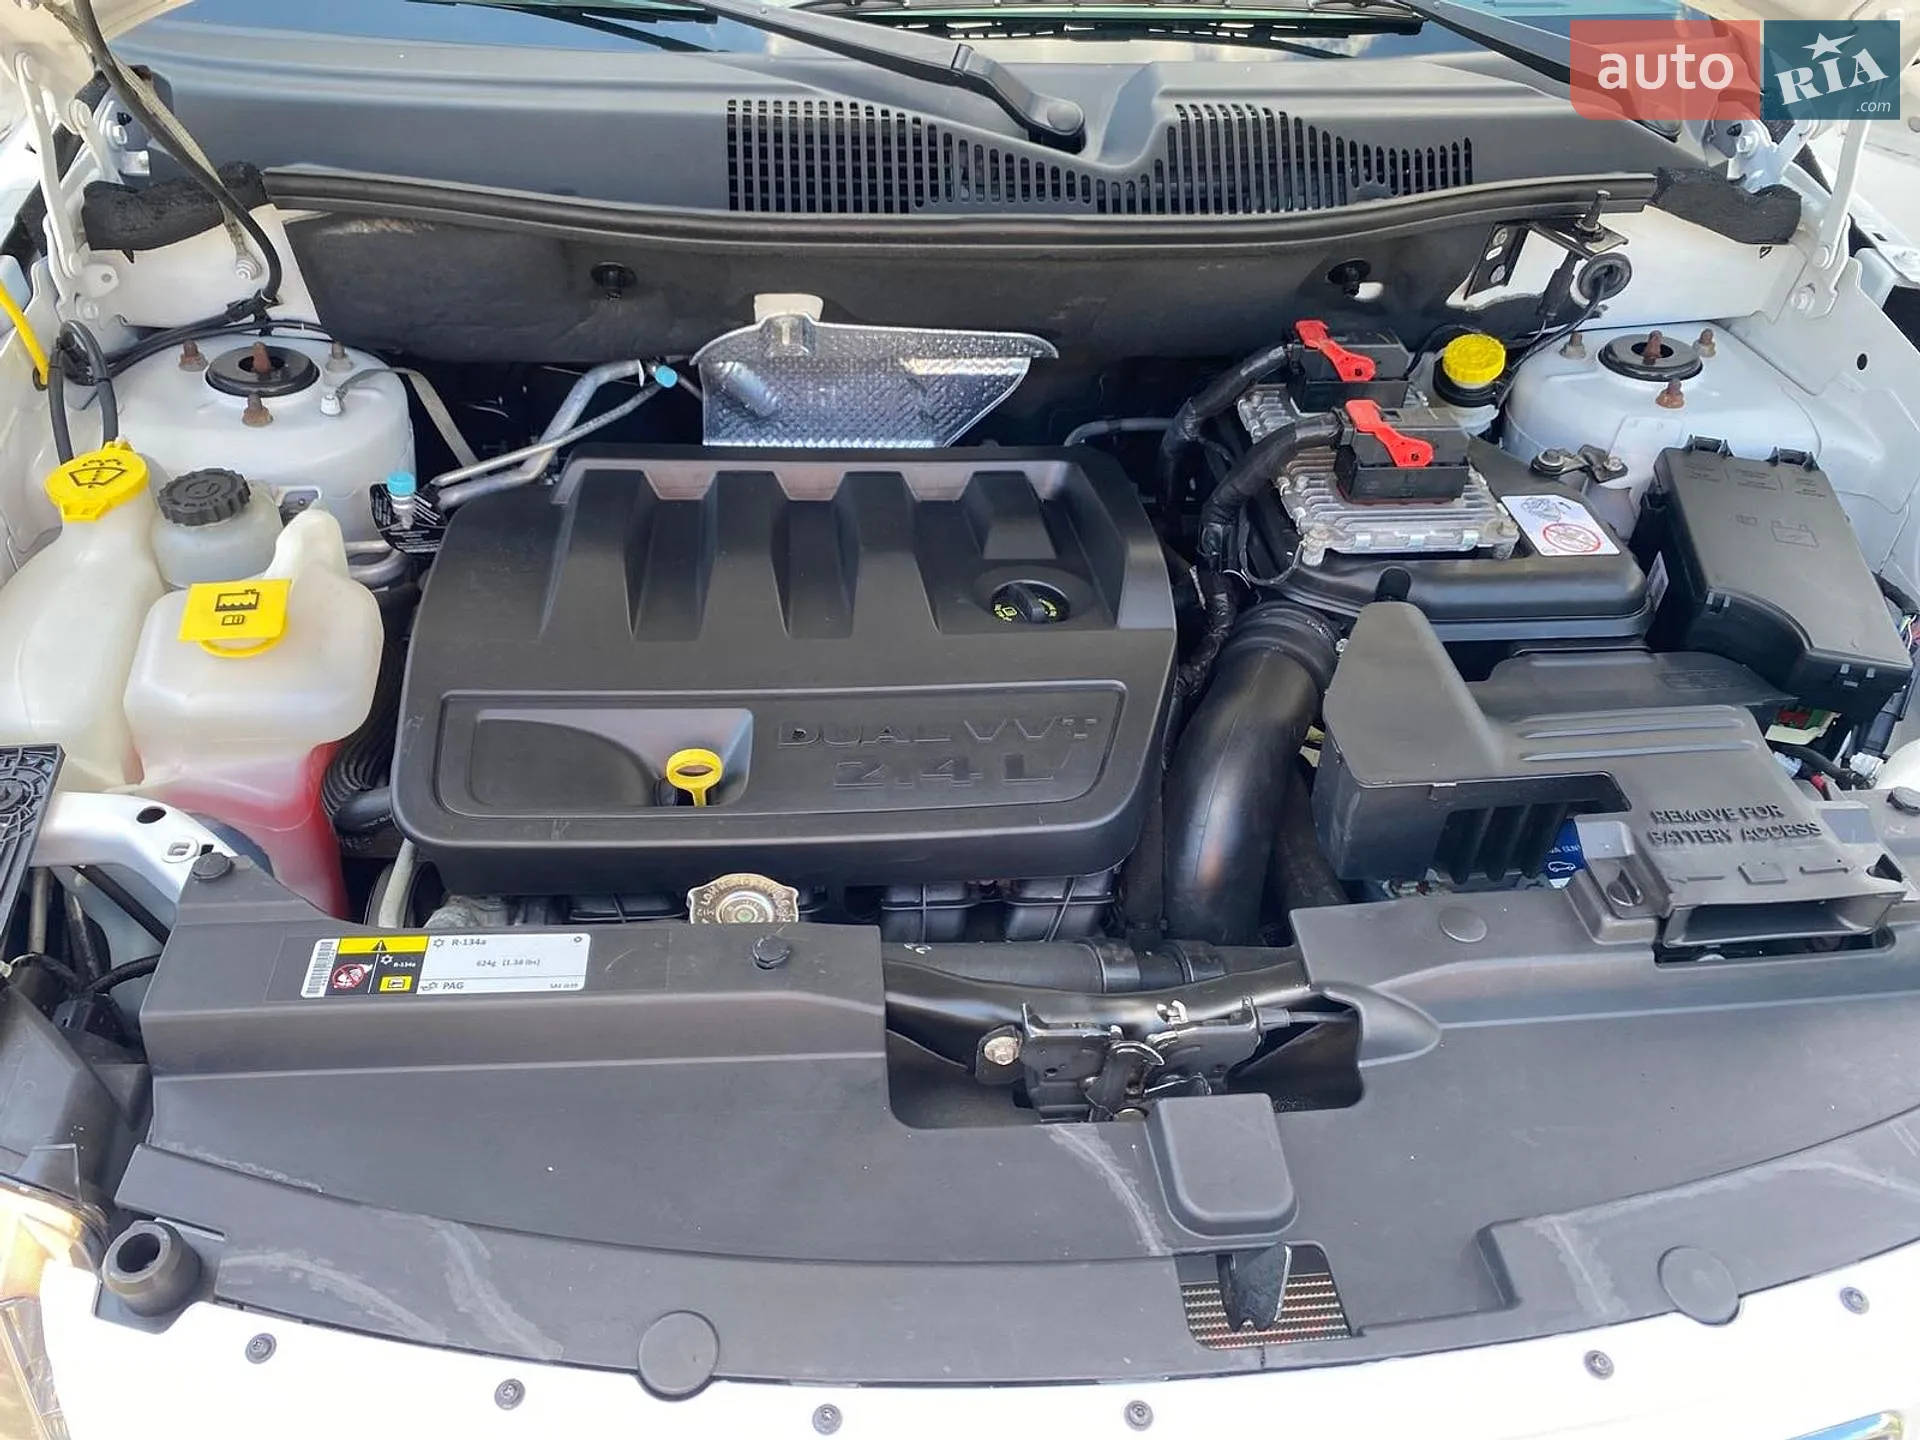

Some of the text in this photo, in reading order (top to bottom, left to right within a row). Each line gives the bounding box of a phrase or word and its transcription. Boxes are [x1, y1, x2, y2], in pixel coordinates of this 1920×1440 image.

[777, 717, 1098, 747] DUAL VVT
[1650, 803, 1784, 824] REMOVE FOR
[1647, 822, 1822, 845] BATTERY ACCESS
[451, 938, 487, 946] R-134a
[442, 981, 465, 990] PAG
